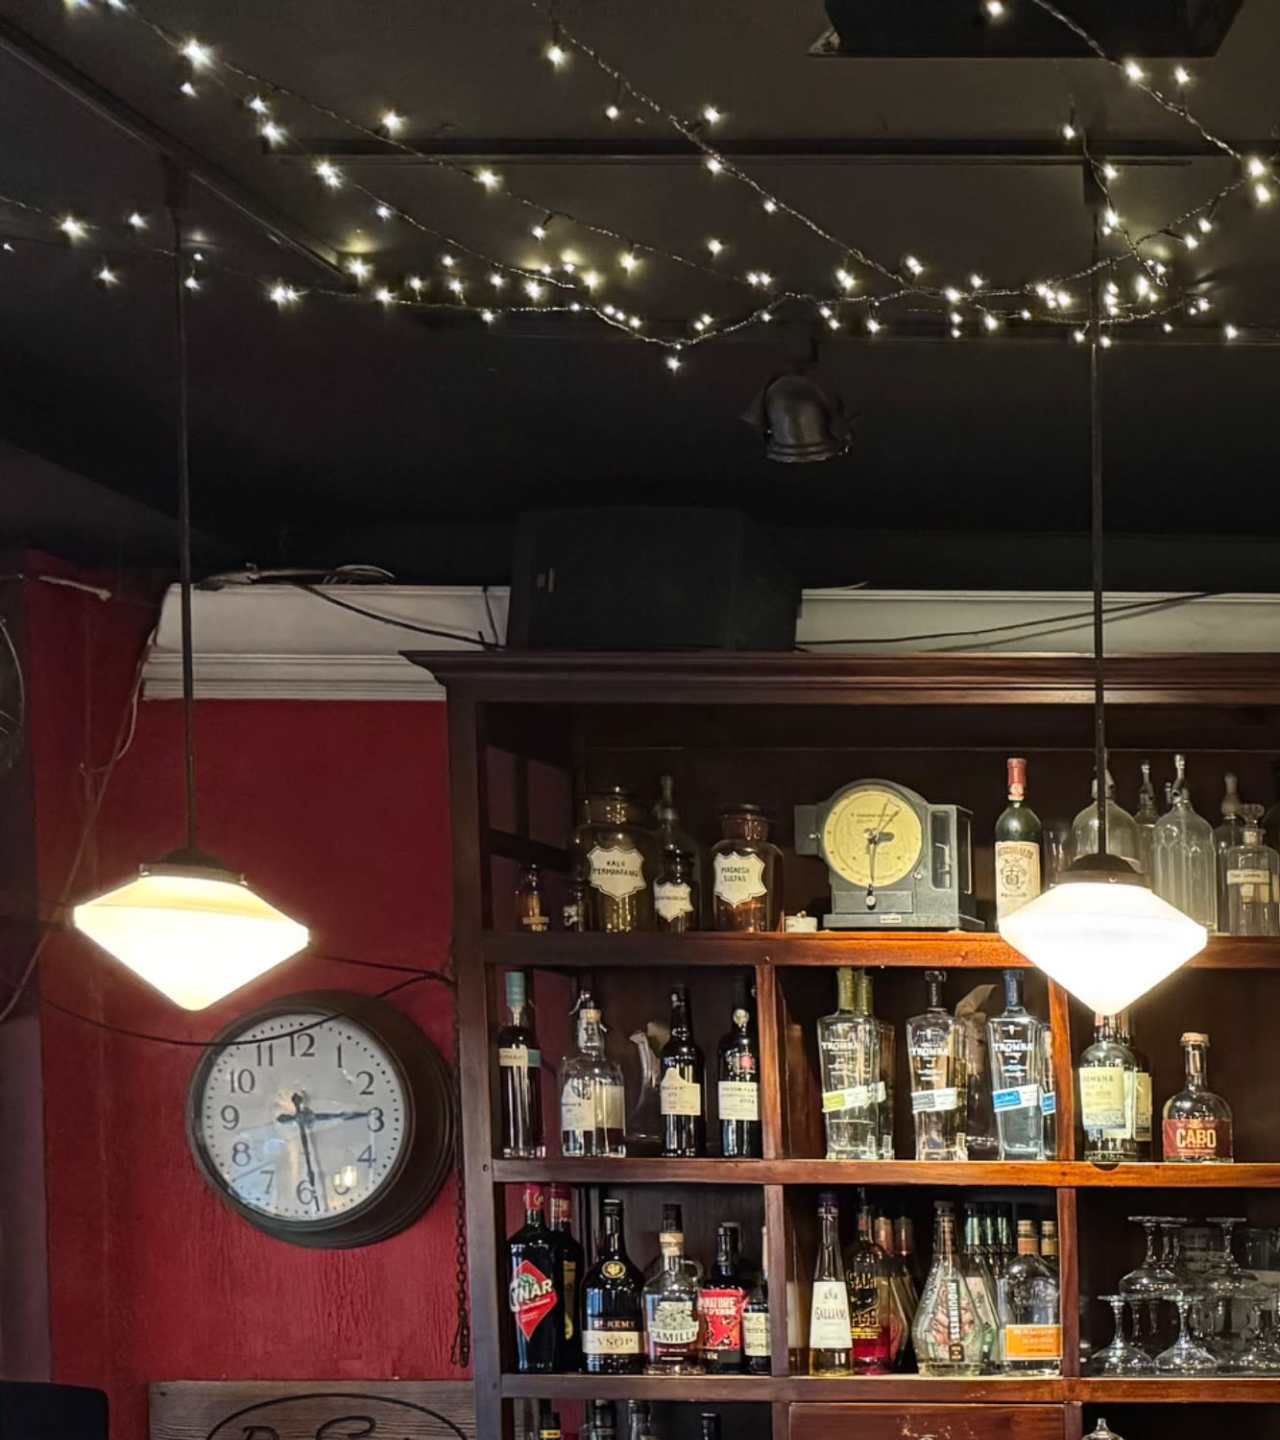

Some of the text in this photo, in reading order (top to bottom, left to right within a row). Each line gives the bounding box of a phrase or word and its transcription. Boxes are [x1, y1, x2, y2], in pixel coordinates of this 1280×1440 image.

[256, 1043, 274, 1067] 11
[290, 1033, 315, 1057] 12
[230, 1069, 255, 1093] 10
[356, 1071, 374, 1095] 2
[220, 1105, 240, 1130] 9
[367, 1107, 385, 1132] 3
[1176, 1129, 1217, 1148] CABO
[232, 1142, 251, 1166] 8
[357, 1145, 376, 1168] 4
[261, 1170, 275, 1195] 7
[297, 1181, 316, 1205] 6
